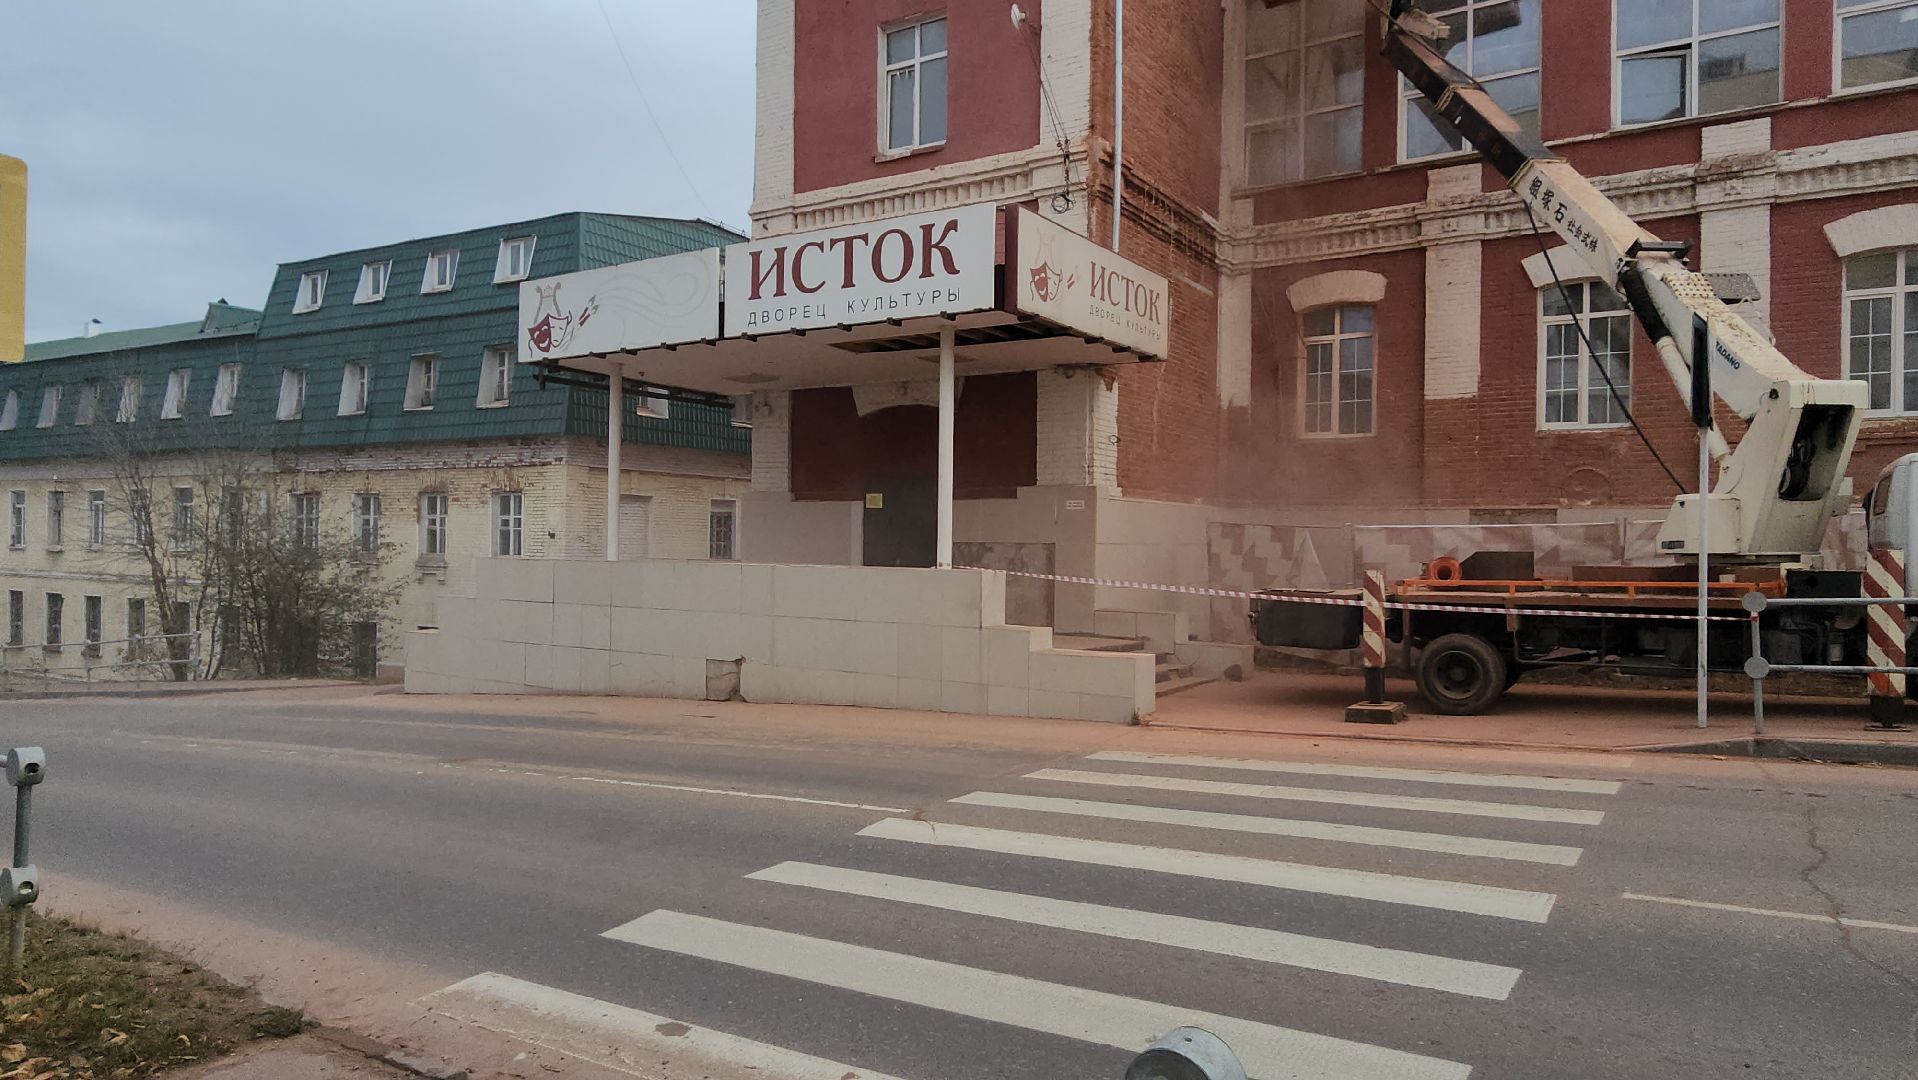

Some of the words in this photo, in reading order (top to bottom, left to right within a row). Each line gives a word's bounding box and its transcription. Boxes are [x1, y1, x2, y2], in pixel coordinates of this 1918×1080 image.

[748, 218, 961, 301] ИСТОК
[747, 303, 827, 328] ДВОРЕЦ
[846, 287, 961, 315] КУЛЬТУРЫ
[1089, 260, 1161, 325] ИСТОК
[1089, 304, 1121, 325] ДВОРЕЦ
[1715, 340, 1741, 370] TADANO
